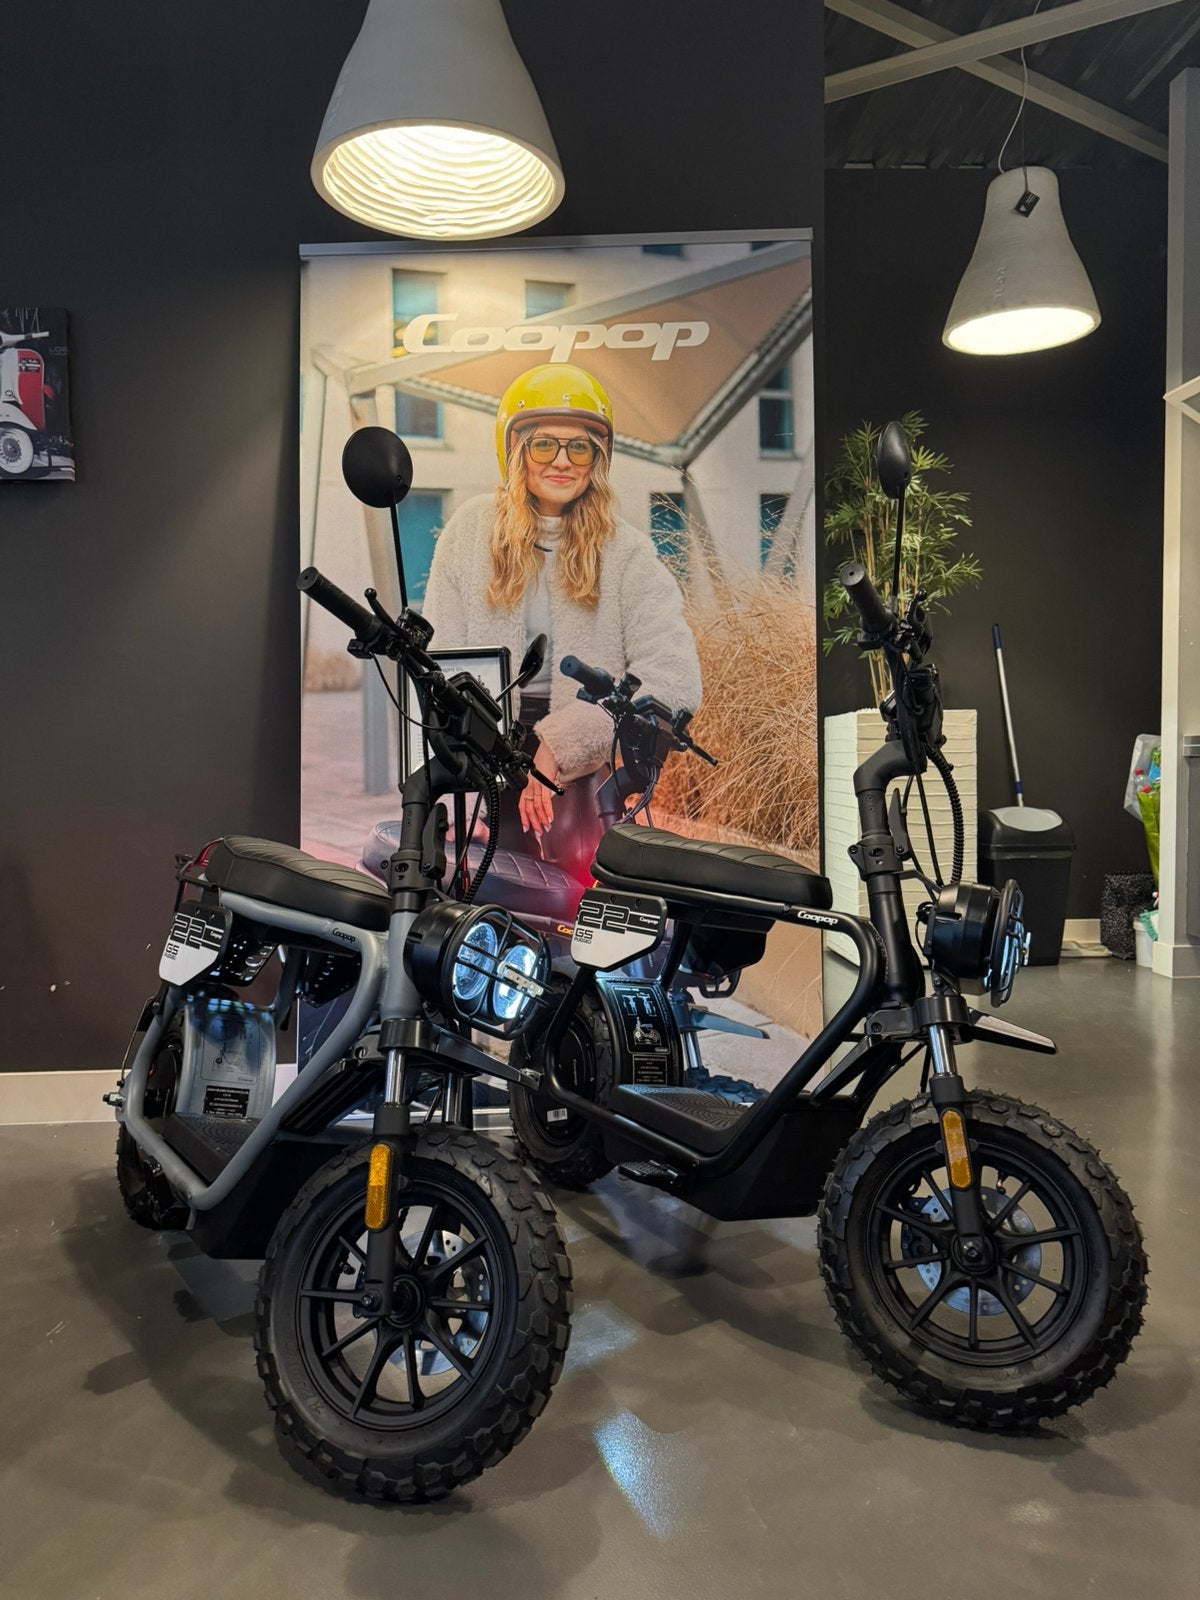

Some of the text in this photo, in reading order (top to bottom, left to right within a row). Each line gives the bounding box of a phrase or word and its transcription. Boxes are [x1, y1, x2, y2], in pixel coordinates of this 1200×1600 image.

[403, 312, 711, 364] Coopop
[578, 899, 630, 935] 22
[797, 910, 839, 926] Coopop
[169, 912, 207, 951] 22
[332, 927, 356, 944] Coopop
[575, 928, 594, 940] GS
[165, 942, 180, 956] GS
